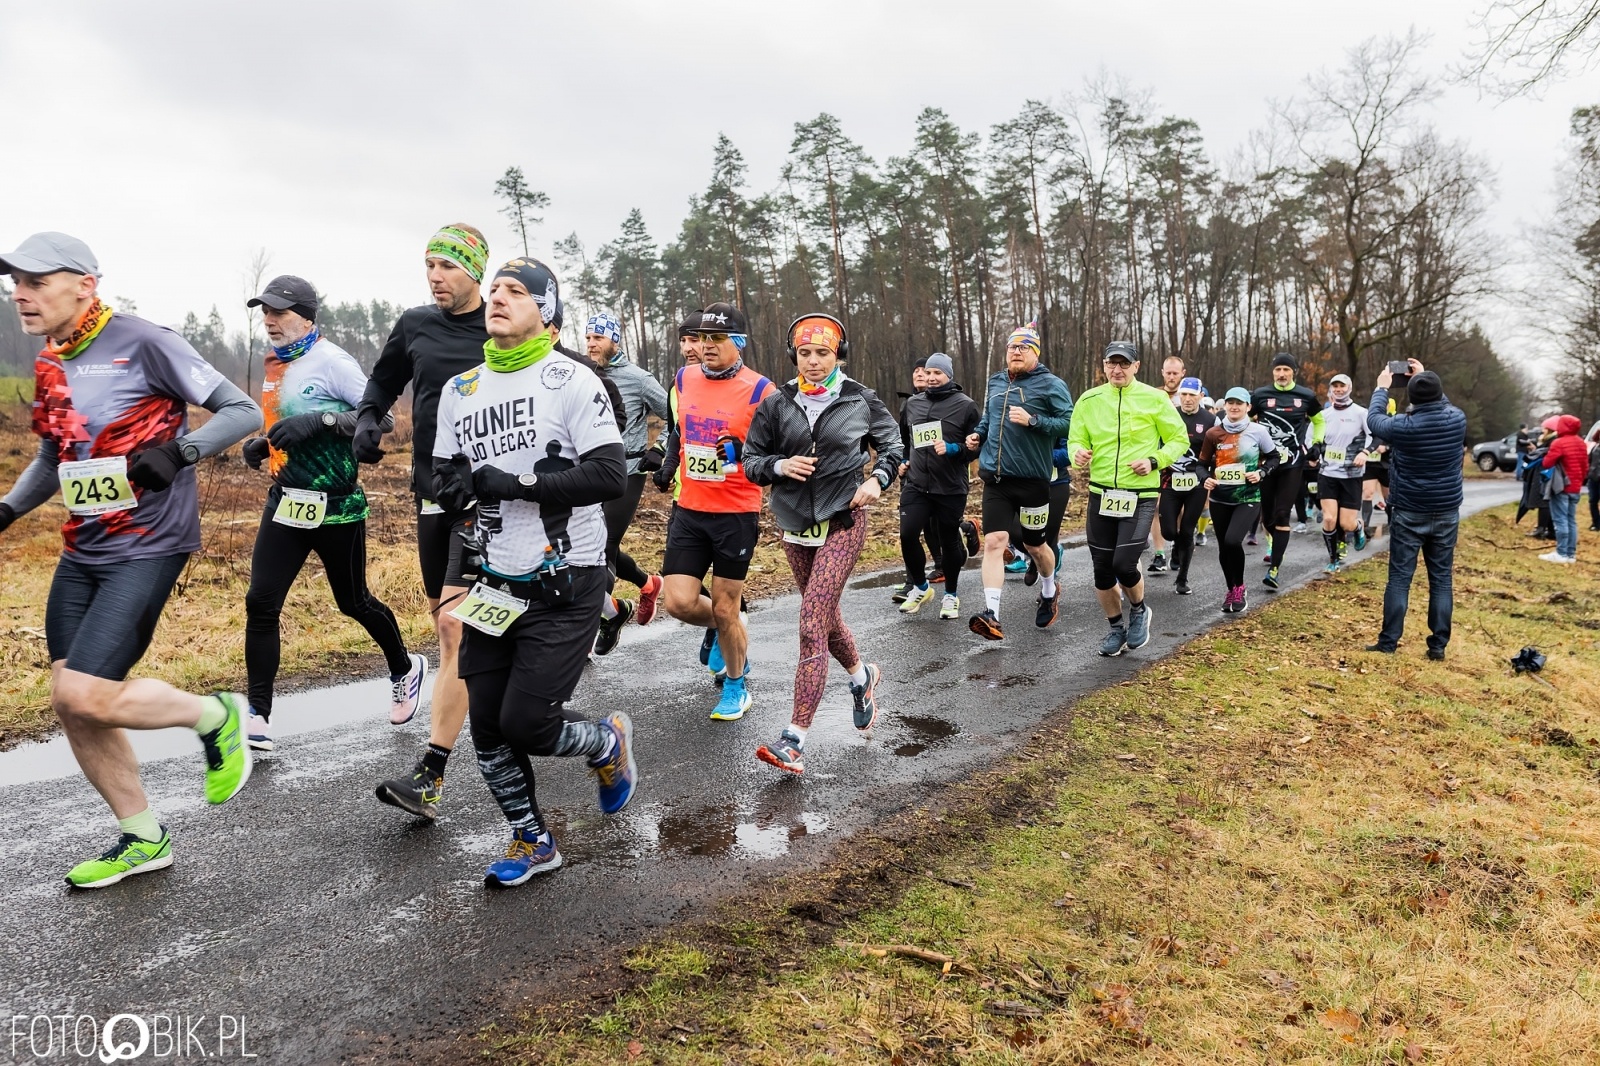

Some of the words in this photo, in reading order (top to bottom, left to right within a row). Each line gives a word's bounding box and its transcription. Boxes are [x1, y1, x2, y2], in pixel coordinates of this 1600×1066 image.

[918, 429, 938, 442] 163
[471, 442, 487, 462] JO
[491, 429, 537, 457] LECA?
[688, 456, 719, 475] 254
[1175, 478, 1194, 487] 210
[1220, 470, 1241, 480] 255
[71, 476, 120, 505] 243
[288, 501, 317, 521] 178
[1105, 498, 1131, 512] 214
[1026, 513, 1047, 525] 186
[468, 602, 511, 627] 159
